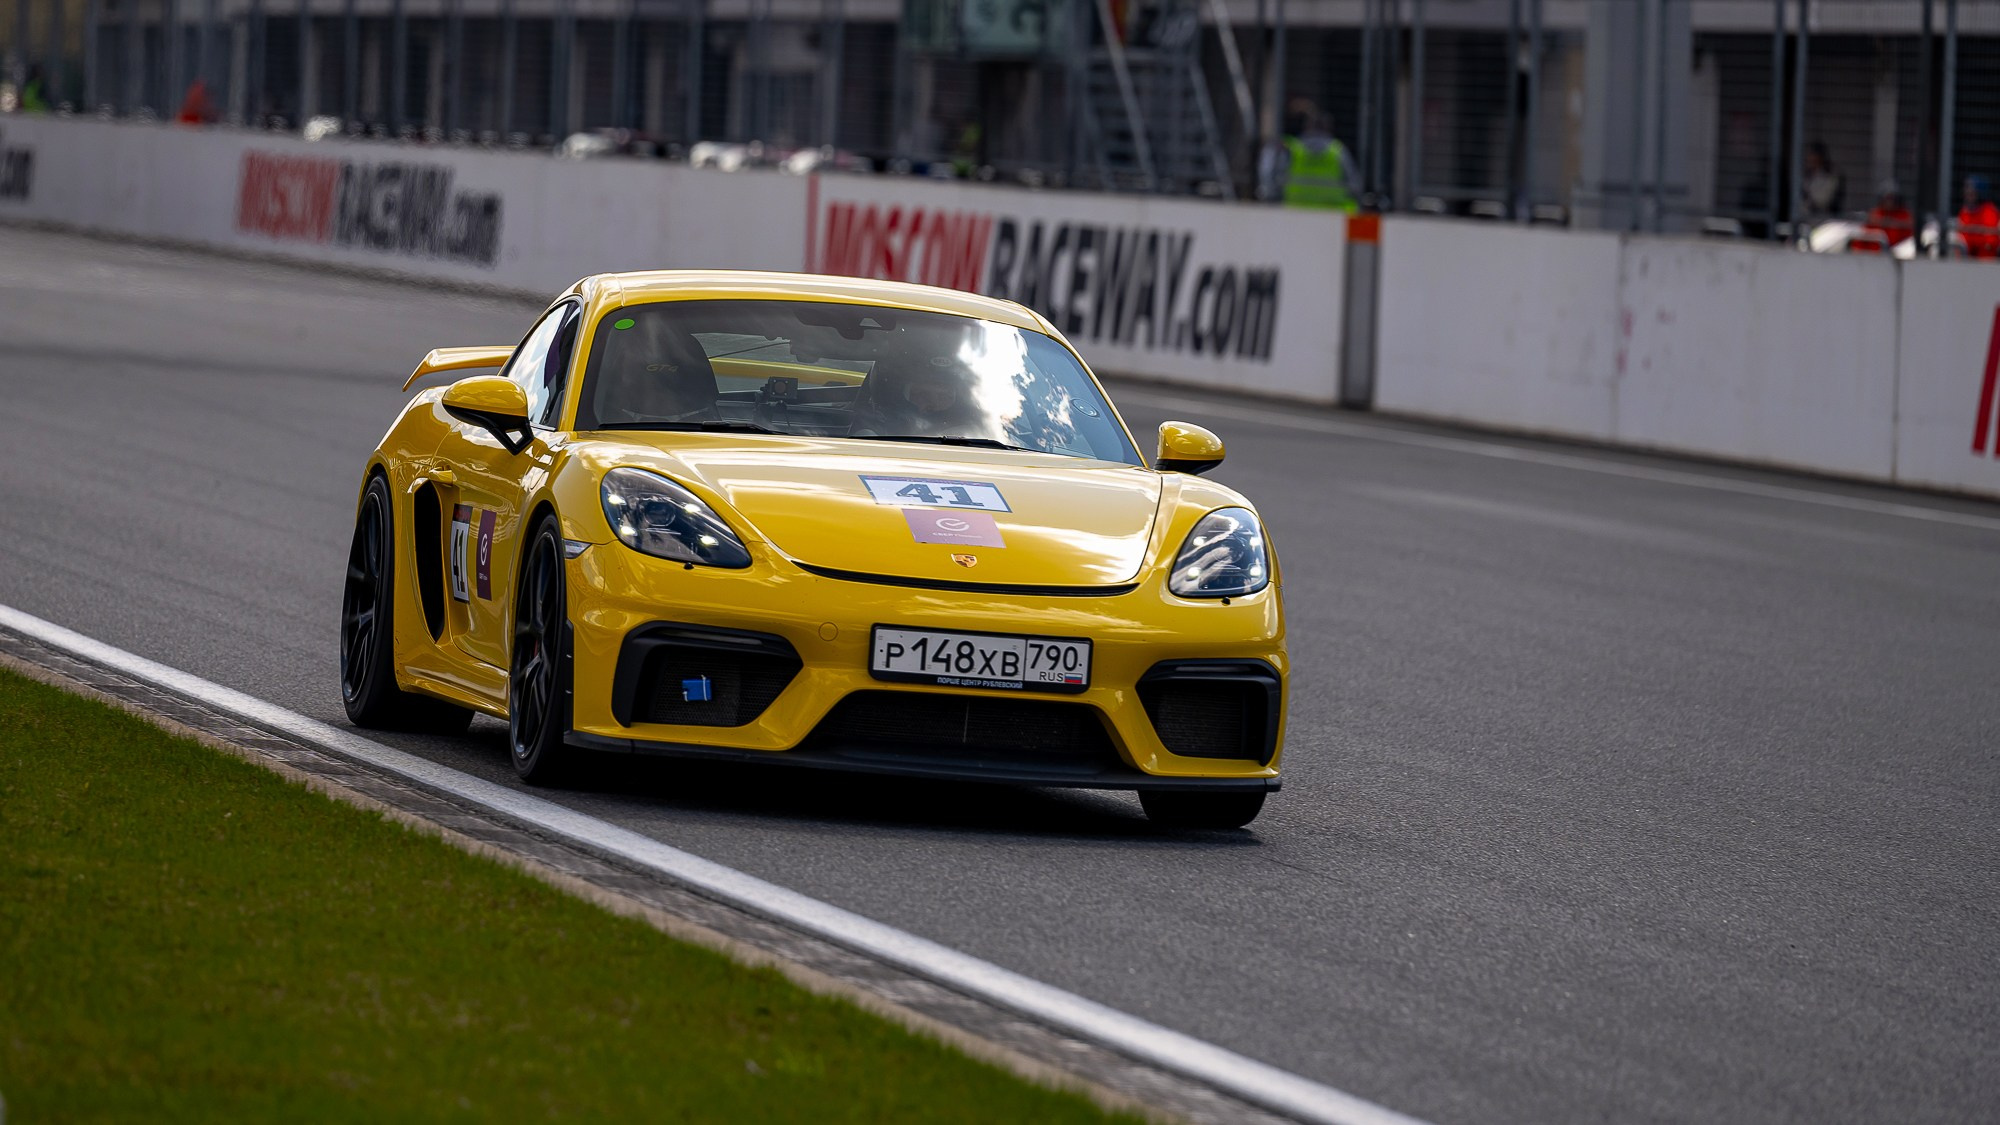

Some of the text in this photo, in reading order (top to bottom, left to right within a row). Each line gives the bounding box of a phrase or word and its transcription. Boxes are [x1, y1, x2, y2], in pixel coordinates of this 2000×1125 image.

[824, 203, 993, 293] MOSCOW
[895, 483, 985, 506] 41
[453, 528, 466, 593] 41
[1028, 643, 1079, 672] 790
[937, 677, 960, 685] ПОРШЕ
[1039, 671, 1064, 682] RUS
